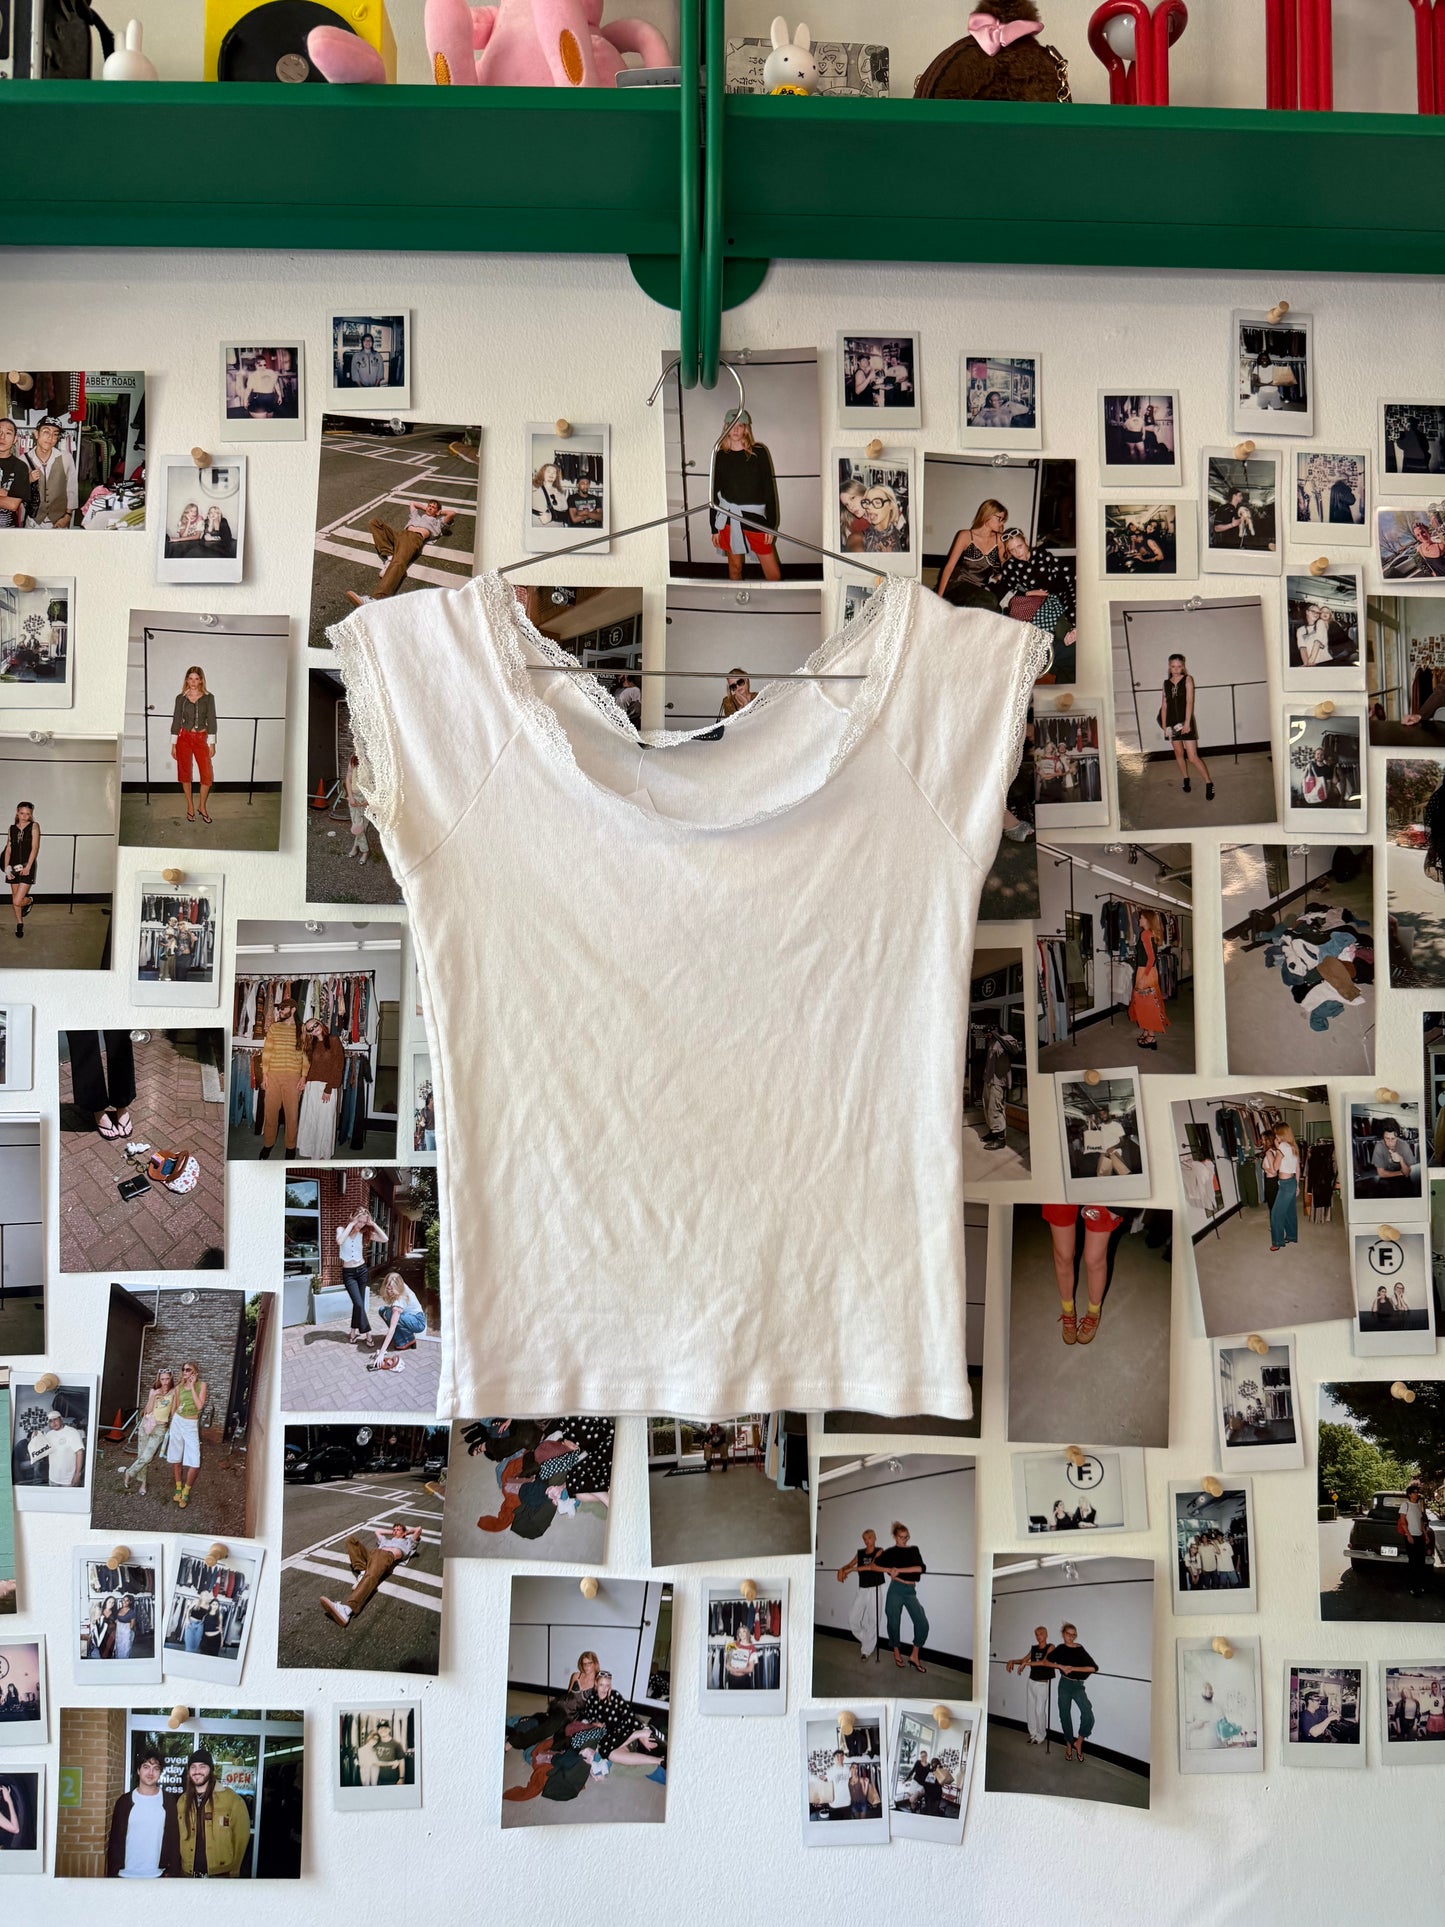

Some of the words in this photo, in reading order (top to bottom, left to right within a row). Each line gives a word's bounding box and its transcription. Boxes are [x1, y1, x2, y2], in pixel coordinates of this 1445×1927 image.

[85, 376, 111, 386] ABBEY
[1378, 1247, 1394, 1267] F.
[31, 1443, 52, 1458] Found.
[164, 1756, 189, 1764] oved
[162, 1764, 185, 1775] yday
[159, 1775, 182, 1784] hion
[225, 1773, 252, 1784] OPEN
